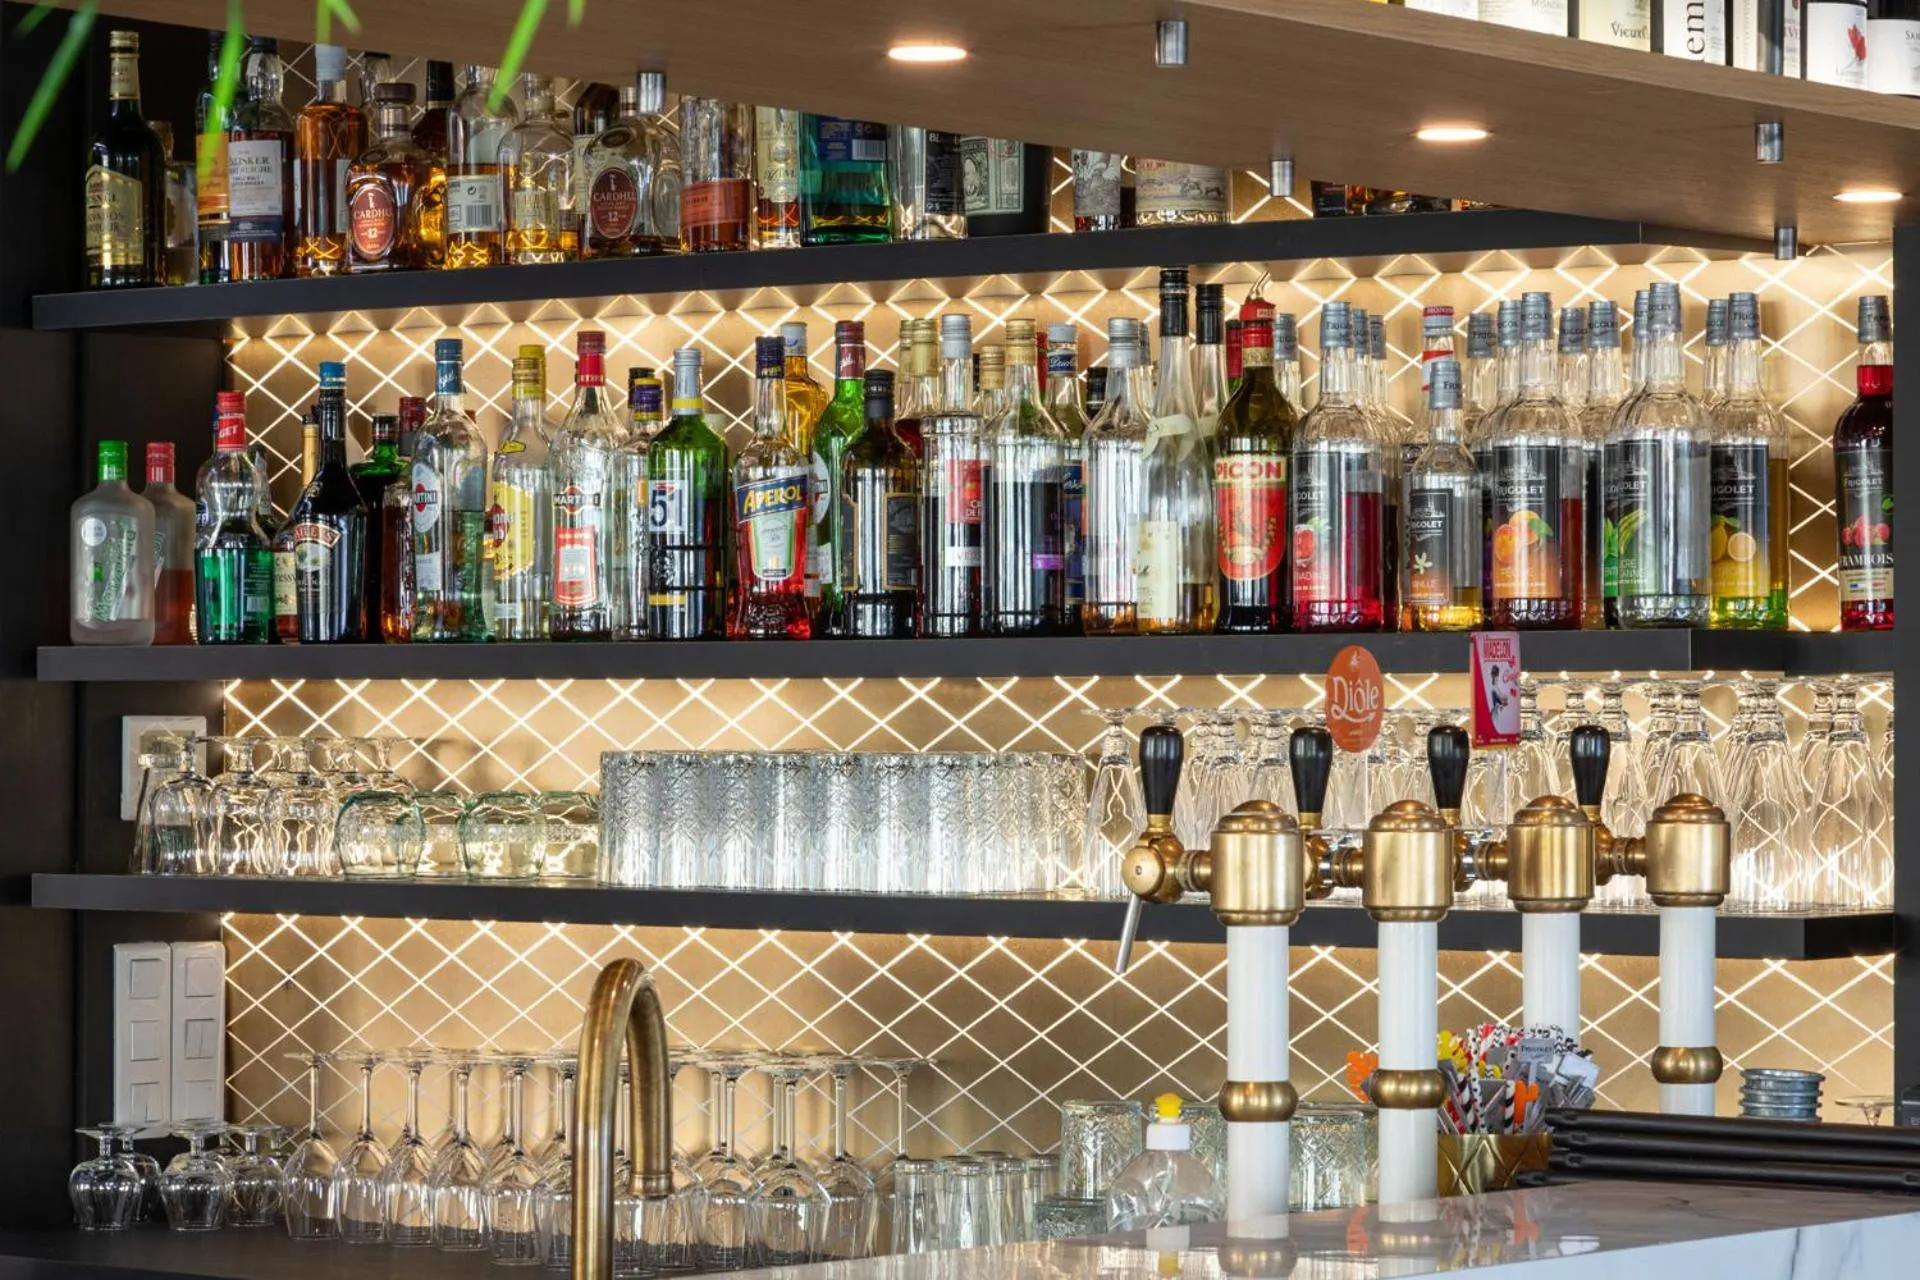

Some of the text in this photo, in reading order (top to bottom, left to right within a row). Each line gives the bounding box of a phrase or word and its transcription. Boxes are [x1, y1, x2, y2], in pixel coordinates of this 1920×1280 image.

[608, 211, 619, 222] 12
[1215, 461, 1282, 480] PICON
[743, 486, 803, 514] APEROL
[1839, 553, 1895, 567] FRAMBOIS
[1331, 677, 1380, 723] Diôle
